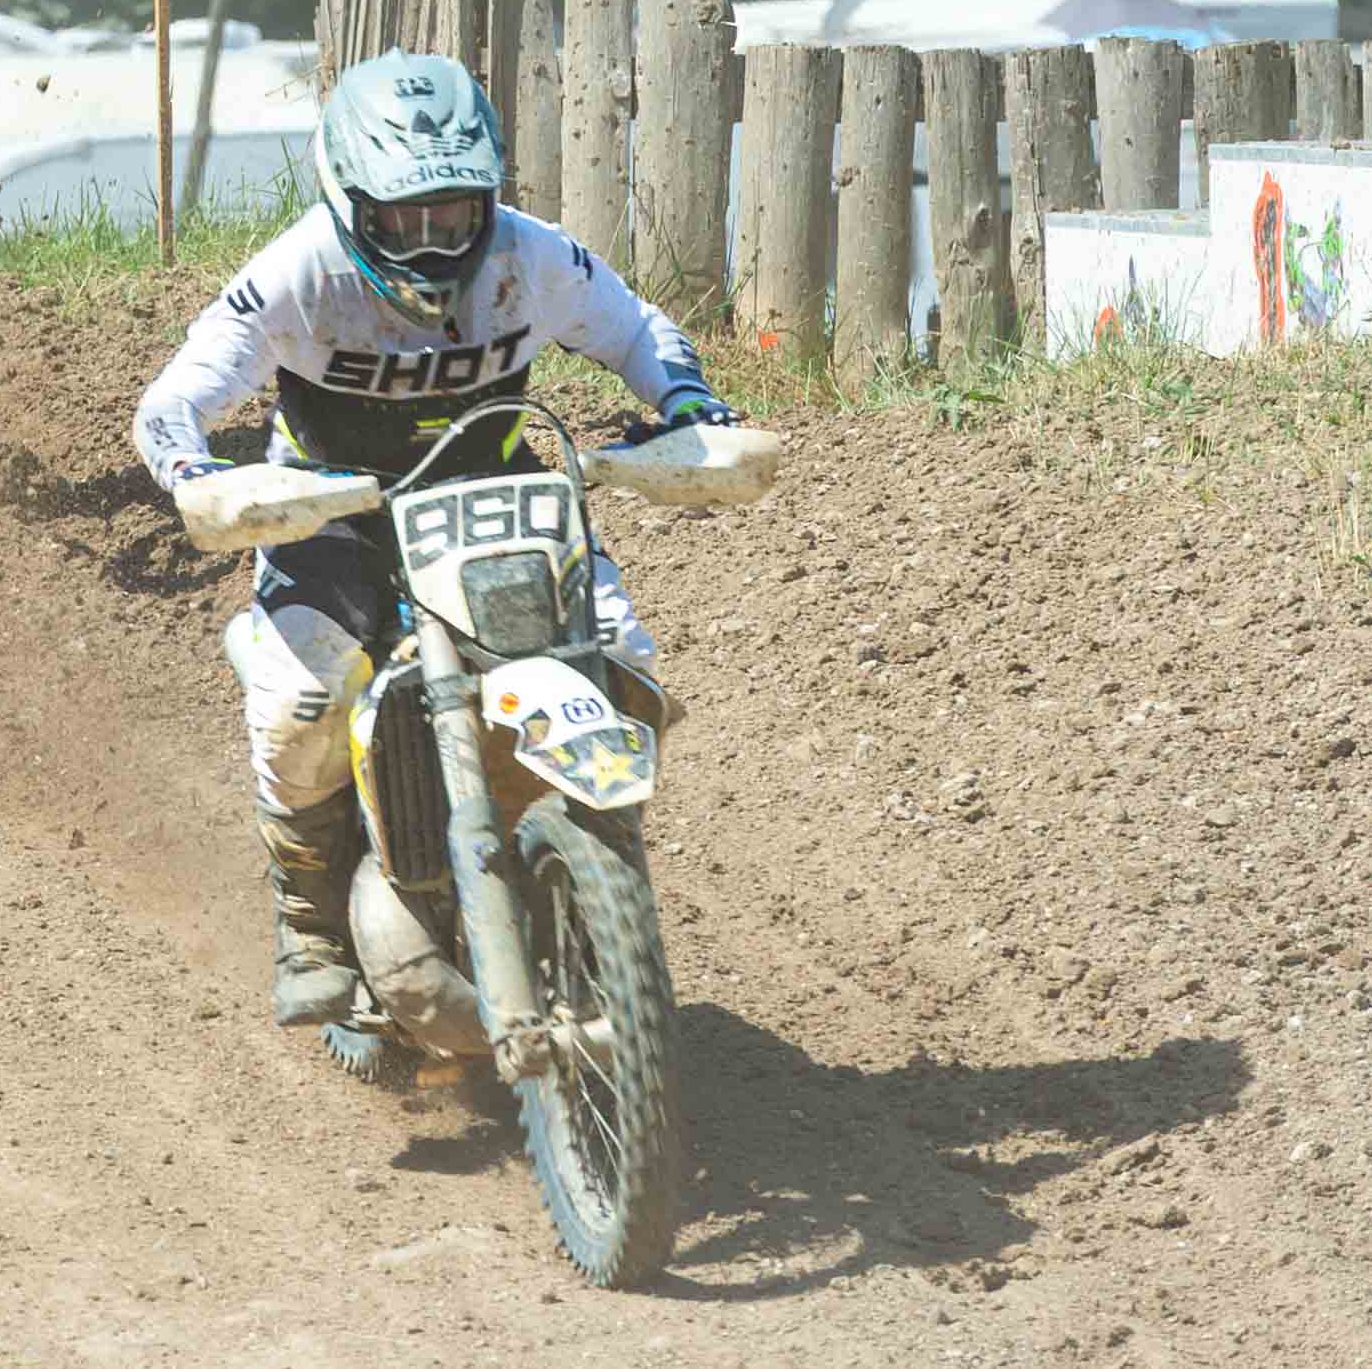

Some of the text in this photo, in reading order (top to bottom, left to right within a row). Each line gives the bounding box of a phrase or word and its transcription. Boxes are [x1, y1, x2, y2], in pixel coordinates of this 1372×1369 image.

[384, 162, 494, 193] adidas
[322, 323, 532, 394] SHOT
[405, 483, 571, 571] 960
